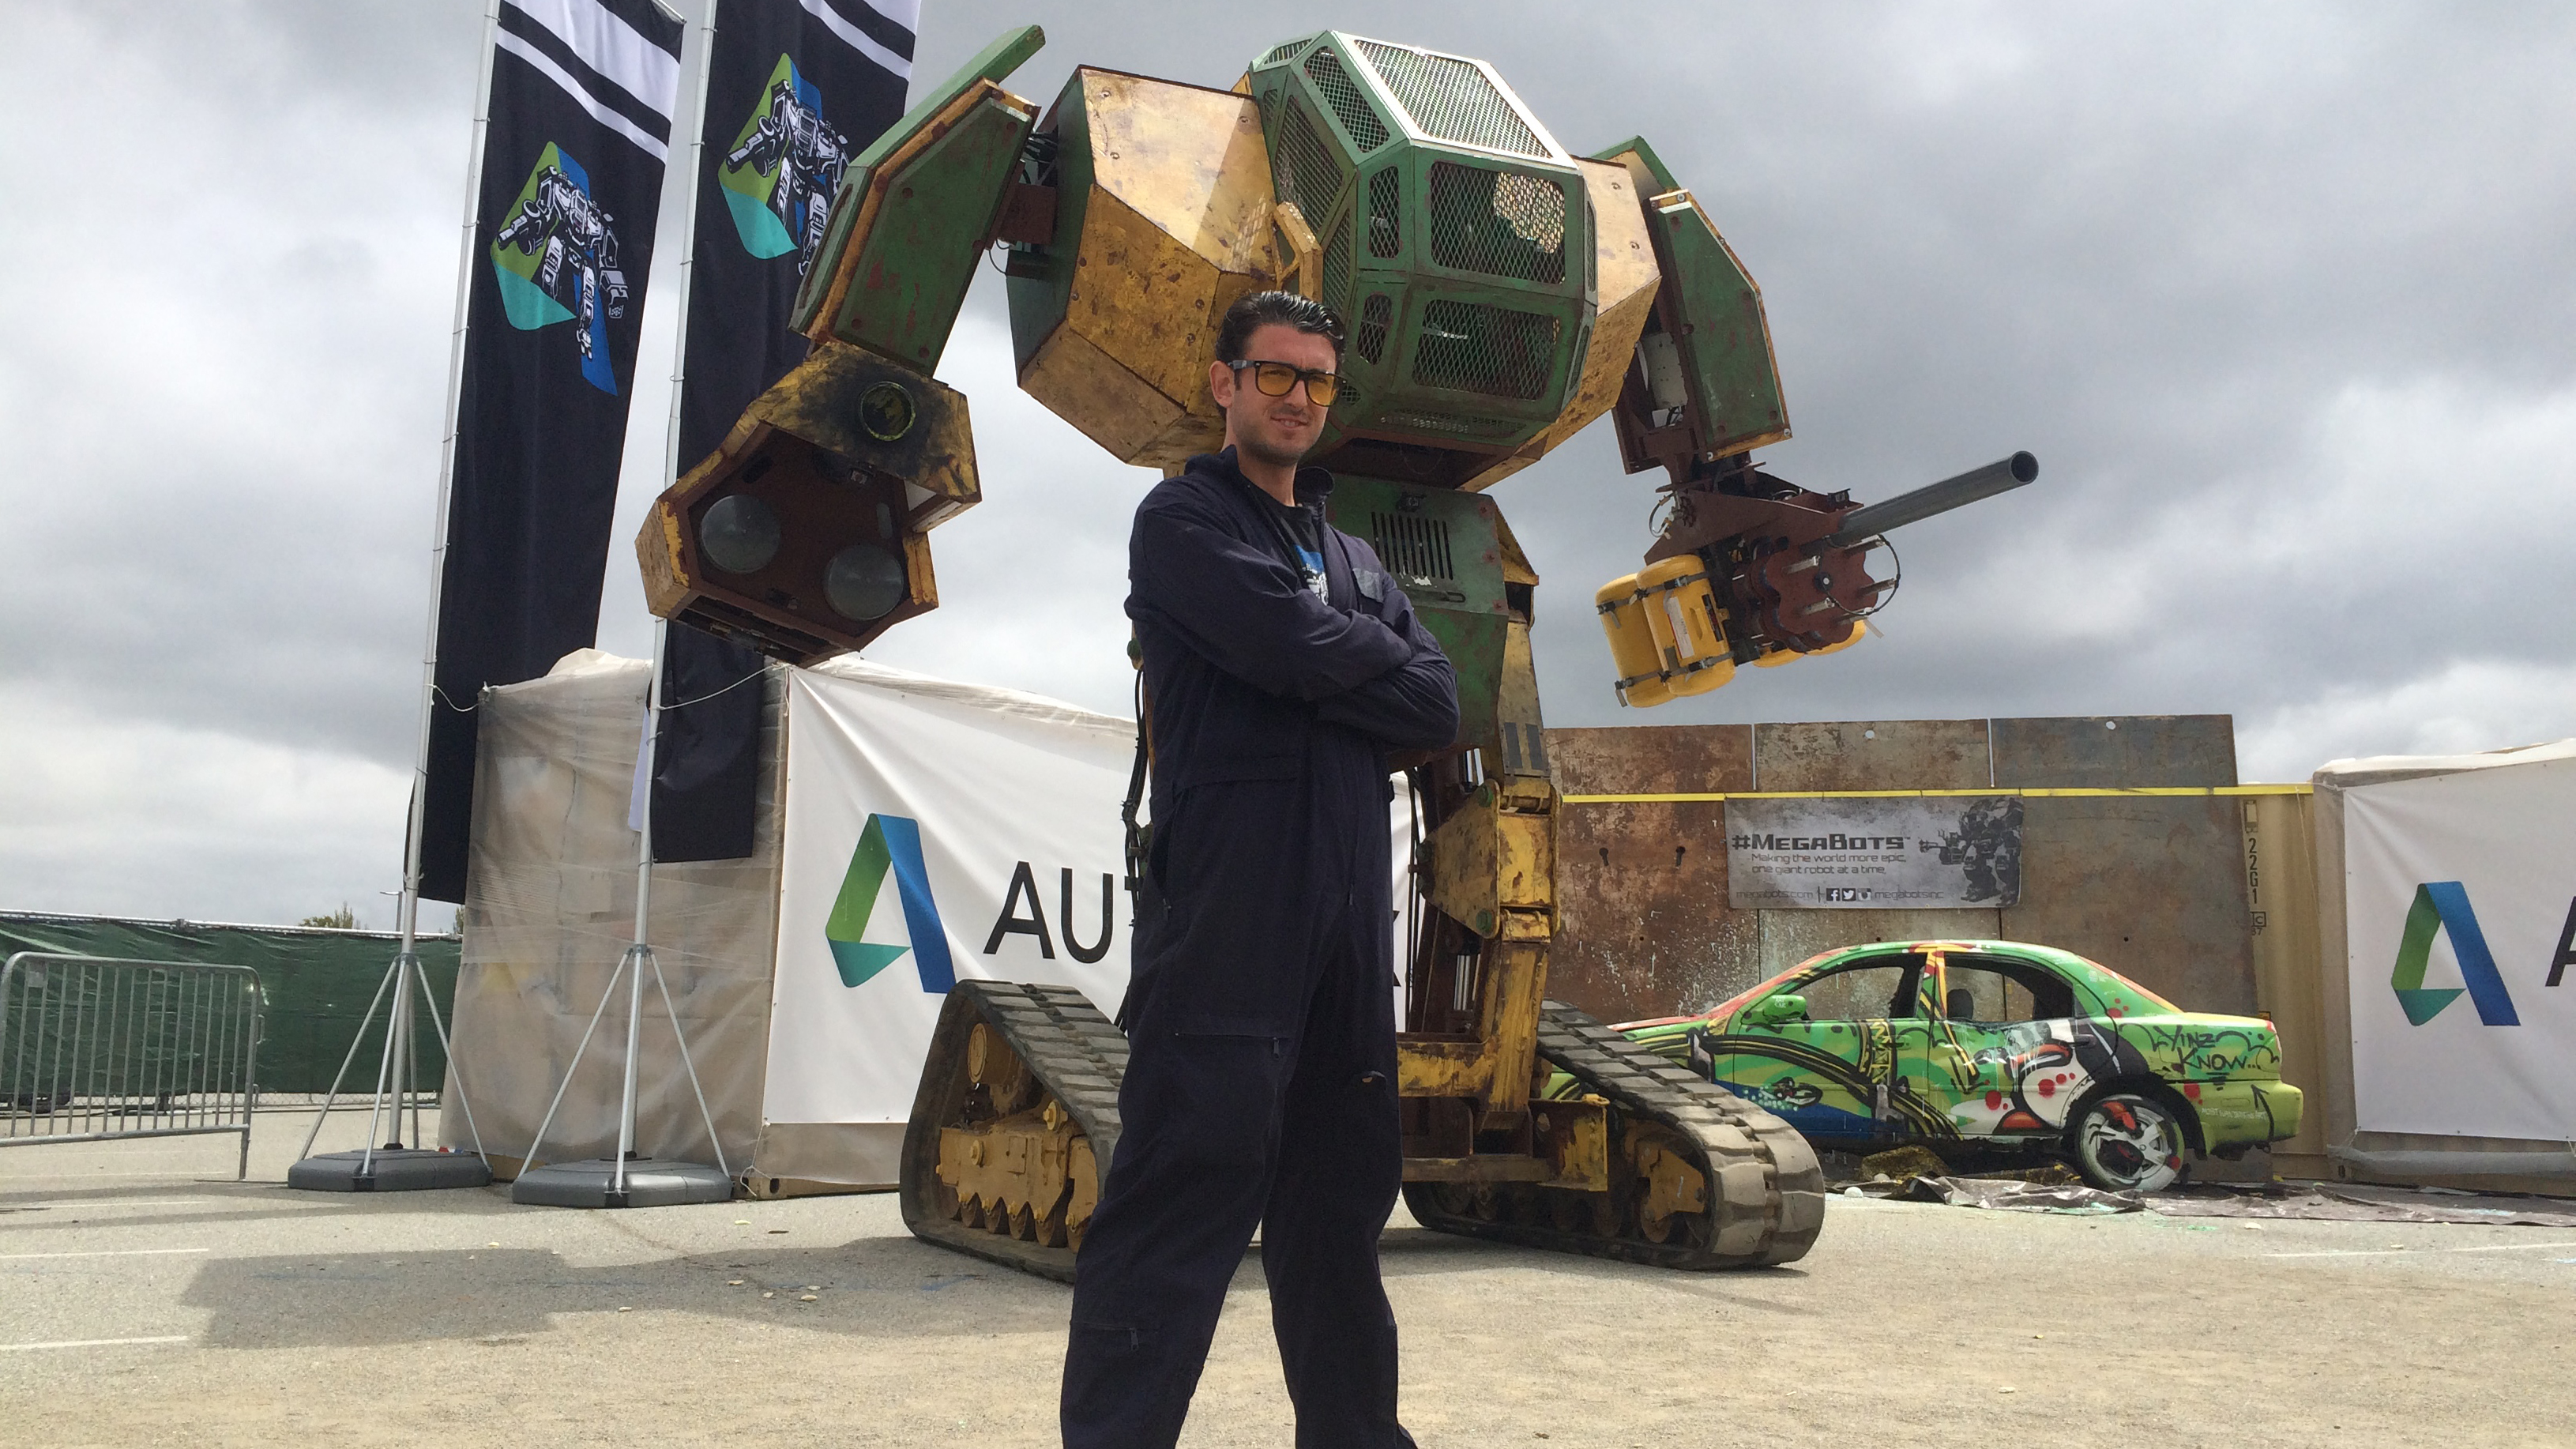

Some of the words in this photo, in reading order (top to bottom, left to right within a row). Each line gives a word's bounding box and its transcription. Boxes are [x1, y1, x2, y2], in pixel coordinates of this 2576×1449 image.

[1751, 853, 1790, 864] Making
[1814, 853, 1846, 862] world
[1775, 865, 1802, 875] giant
[1804, 865, 1834, 874] robot
[1837, 865, 1848, 874] at
[2248, 837, 2258, 904] 22G1
